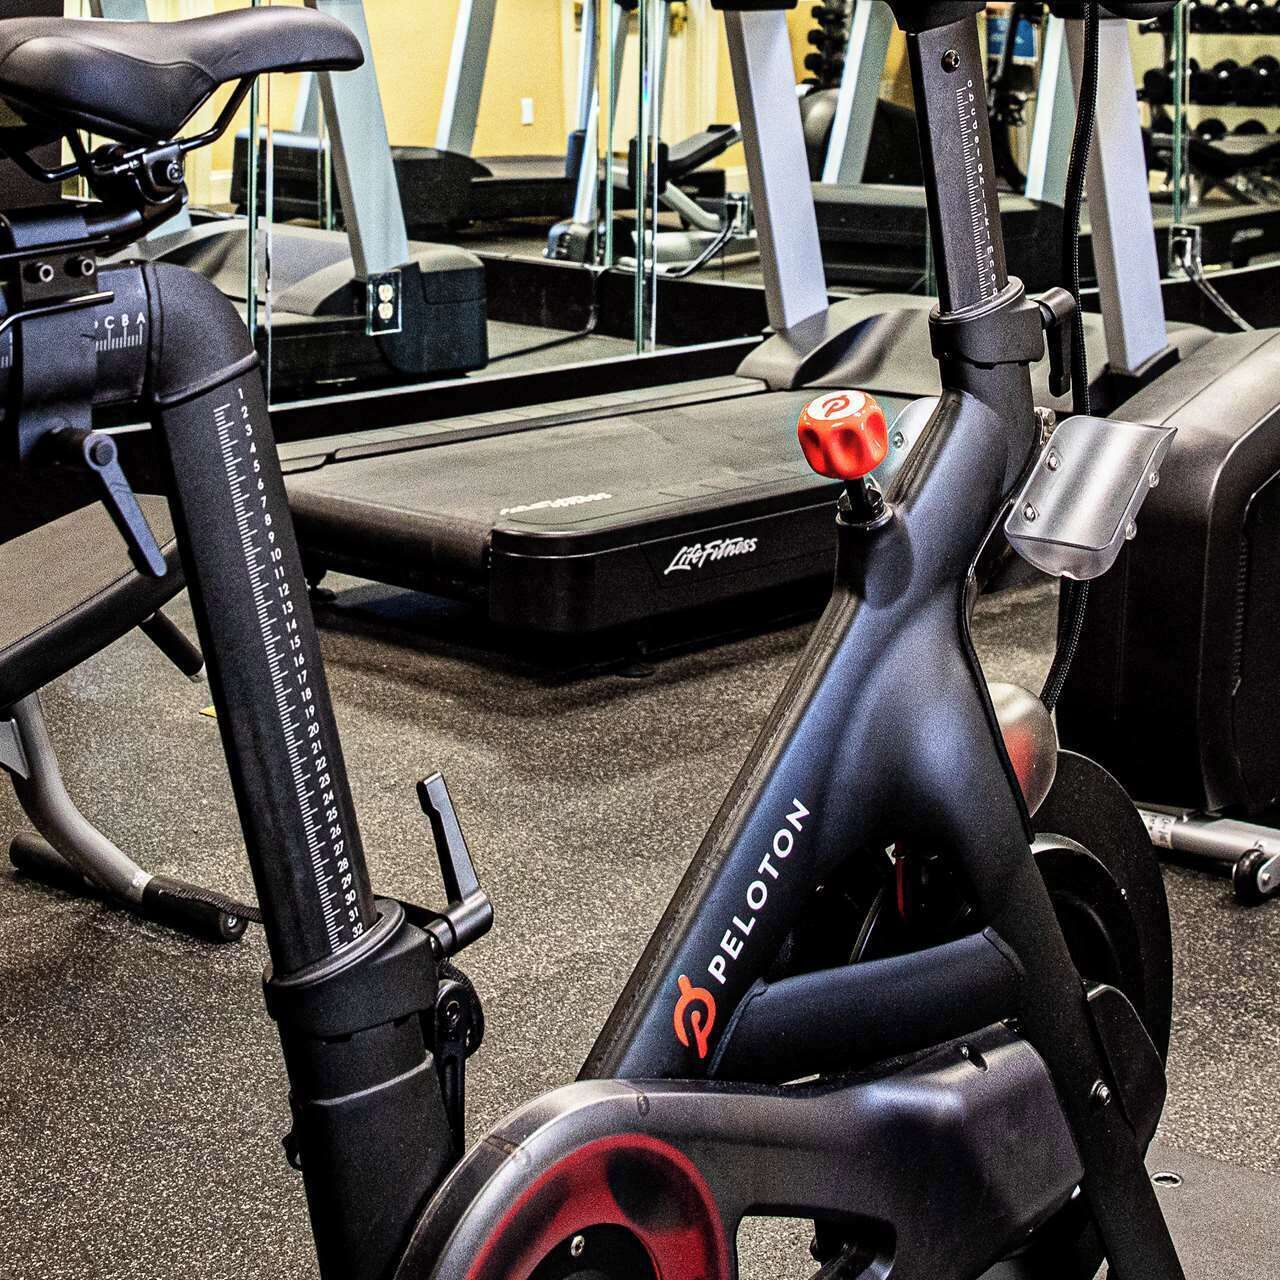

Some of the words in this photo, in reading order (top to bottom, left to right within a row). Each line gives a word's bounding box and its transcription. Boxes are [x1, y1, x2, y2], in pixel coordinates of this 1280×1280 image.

[121, 314, 130, 327] B
[136, 312, 146, 324] A
[241, 406, 248, 418] 2
[245, 424, 252, 436] 3
[250, 442, 256, 454] 4
[253, 460, 260, 472] 5
[257, 478, 264, 490] 6
[260, 496, 267, 508] 7
[265, 513, 272, 526] 8
[268, 531, 275, 543] 9
[271, 548, 282, 562] 10
[274, 566, 284, 579] 11
[278, 583, 290, 598] 12
[282, 600, 294, 614] 13
[286, 618, 298, 632] 14
[290, 635, 301, 650] 15
[294, 653, 304, 668] 16
[297, 670, 308, 685] 17
[301, 688, 312, 702] 18
[304, 704, 315, 720] 19
[307, 722, 320, 738] 20
[311, 740, 322, 754] 21
[315, 756, 327, 772] 22
[319, 773, 330, 788] 23
[322, 790, 334, 806] 24
[326, 806, 338, 822] 25
[330, 824, 342, 840] 26
[334, 840, 344, 856] 27
[338, 858, 349, 873] 28
[341, 874, 352, 890] 29
[345, 890, 356, 906] 30
[708, 798, 810, 985] PELOTON
[348, 906, 358, 922] 31
[352, 922, 364, 938] 32
